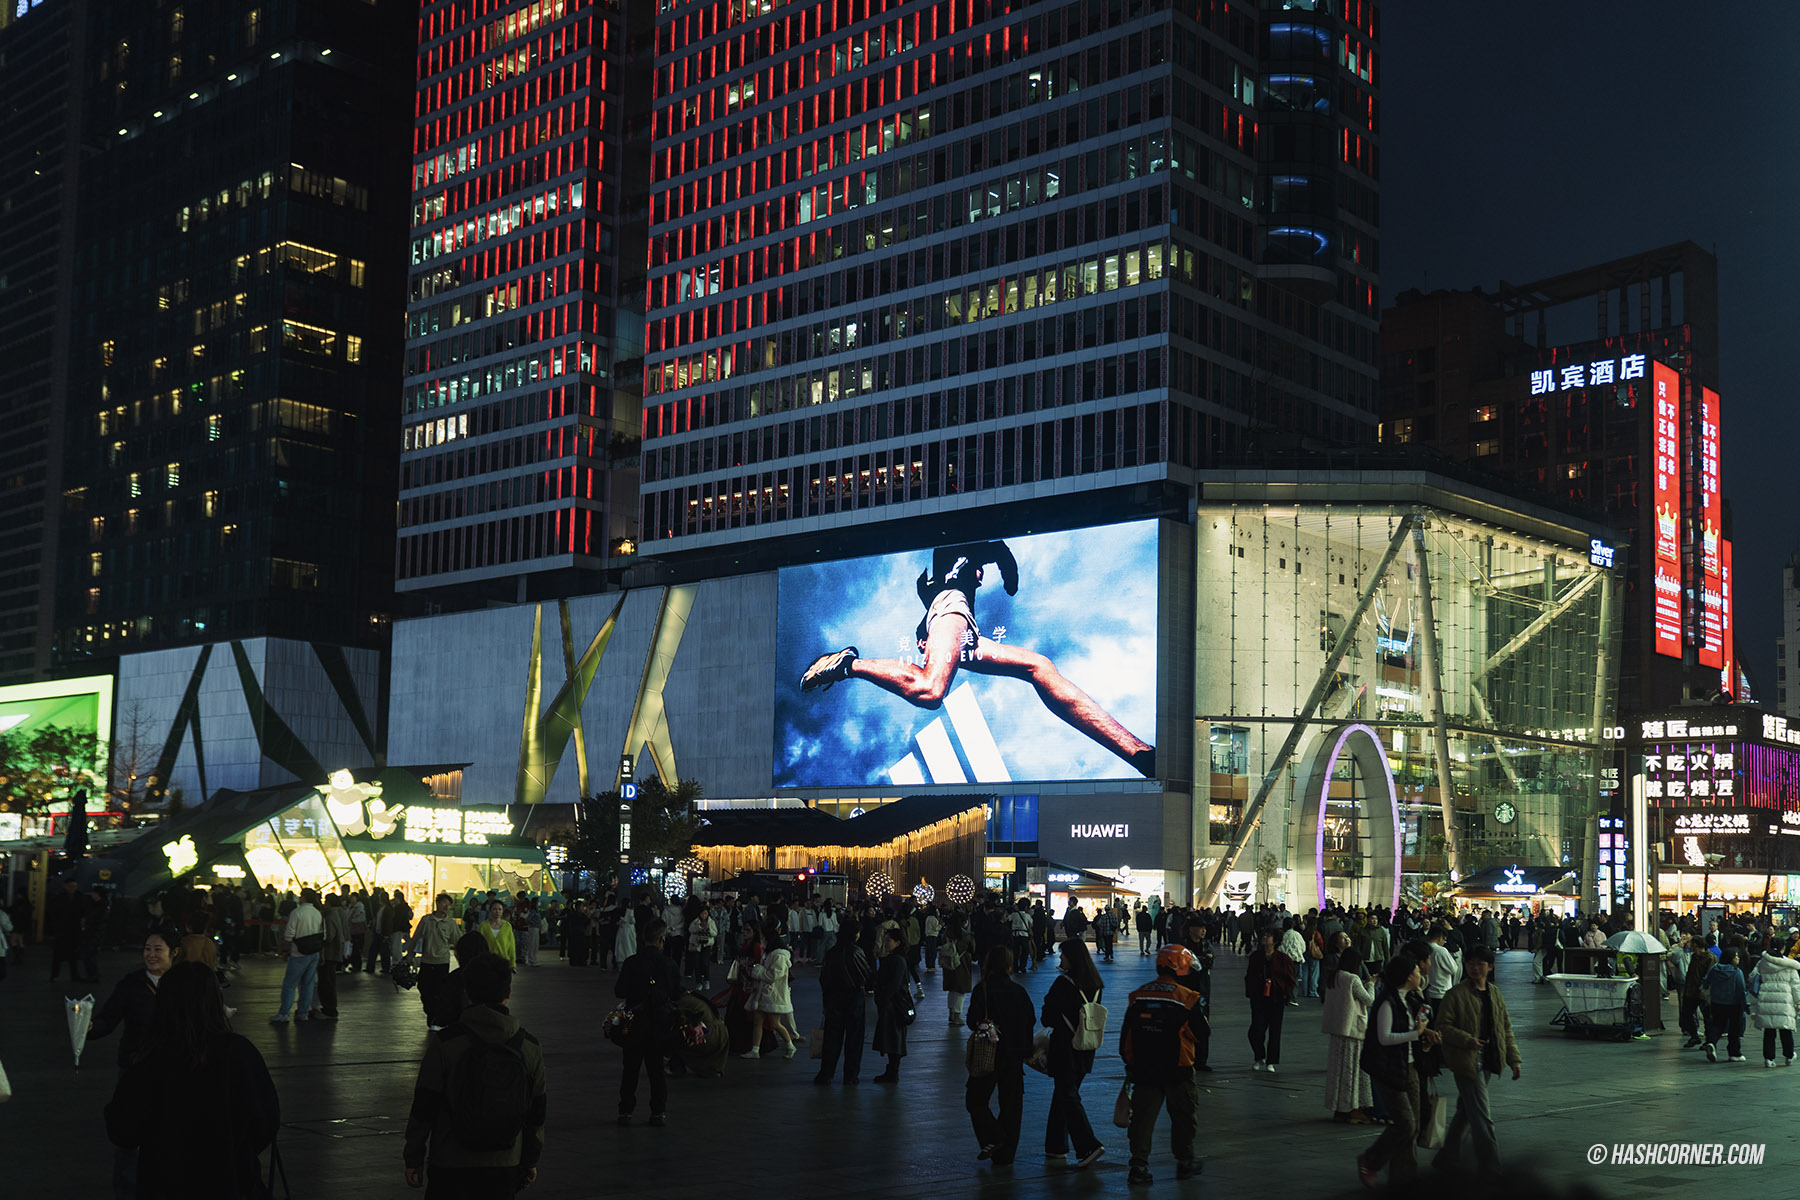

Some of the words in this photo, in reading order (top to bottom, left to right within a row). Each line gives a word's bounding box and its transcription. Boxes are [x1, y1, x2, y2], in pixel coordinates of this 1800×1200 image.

[1531, 354, 1646, 395] 凯宾酒店
[1590, 539, 1615, 559] Silver
[898, 652, 952, 667] ADIZEO
[960, 648, 983, 662] EVO
[1646, 753, 1734, 772] 不吃火锅
[626, 785, 636, 798] D
[1071, 824, 1129, 838] HUAWEI
